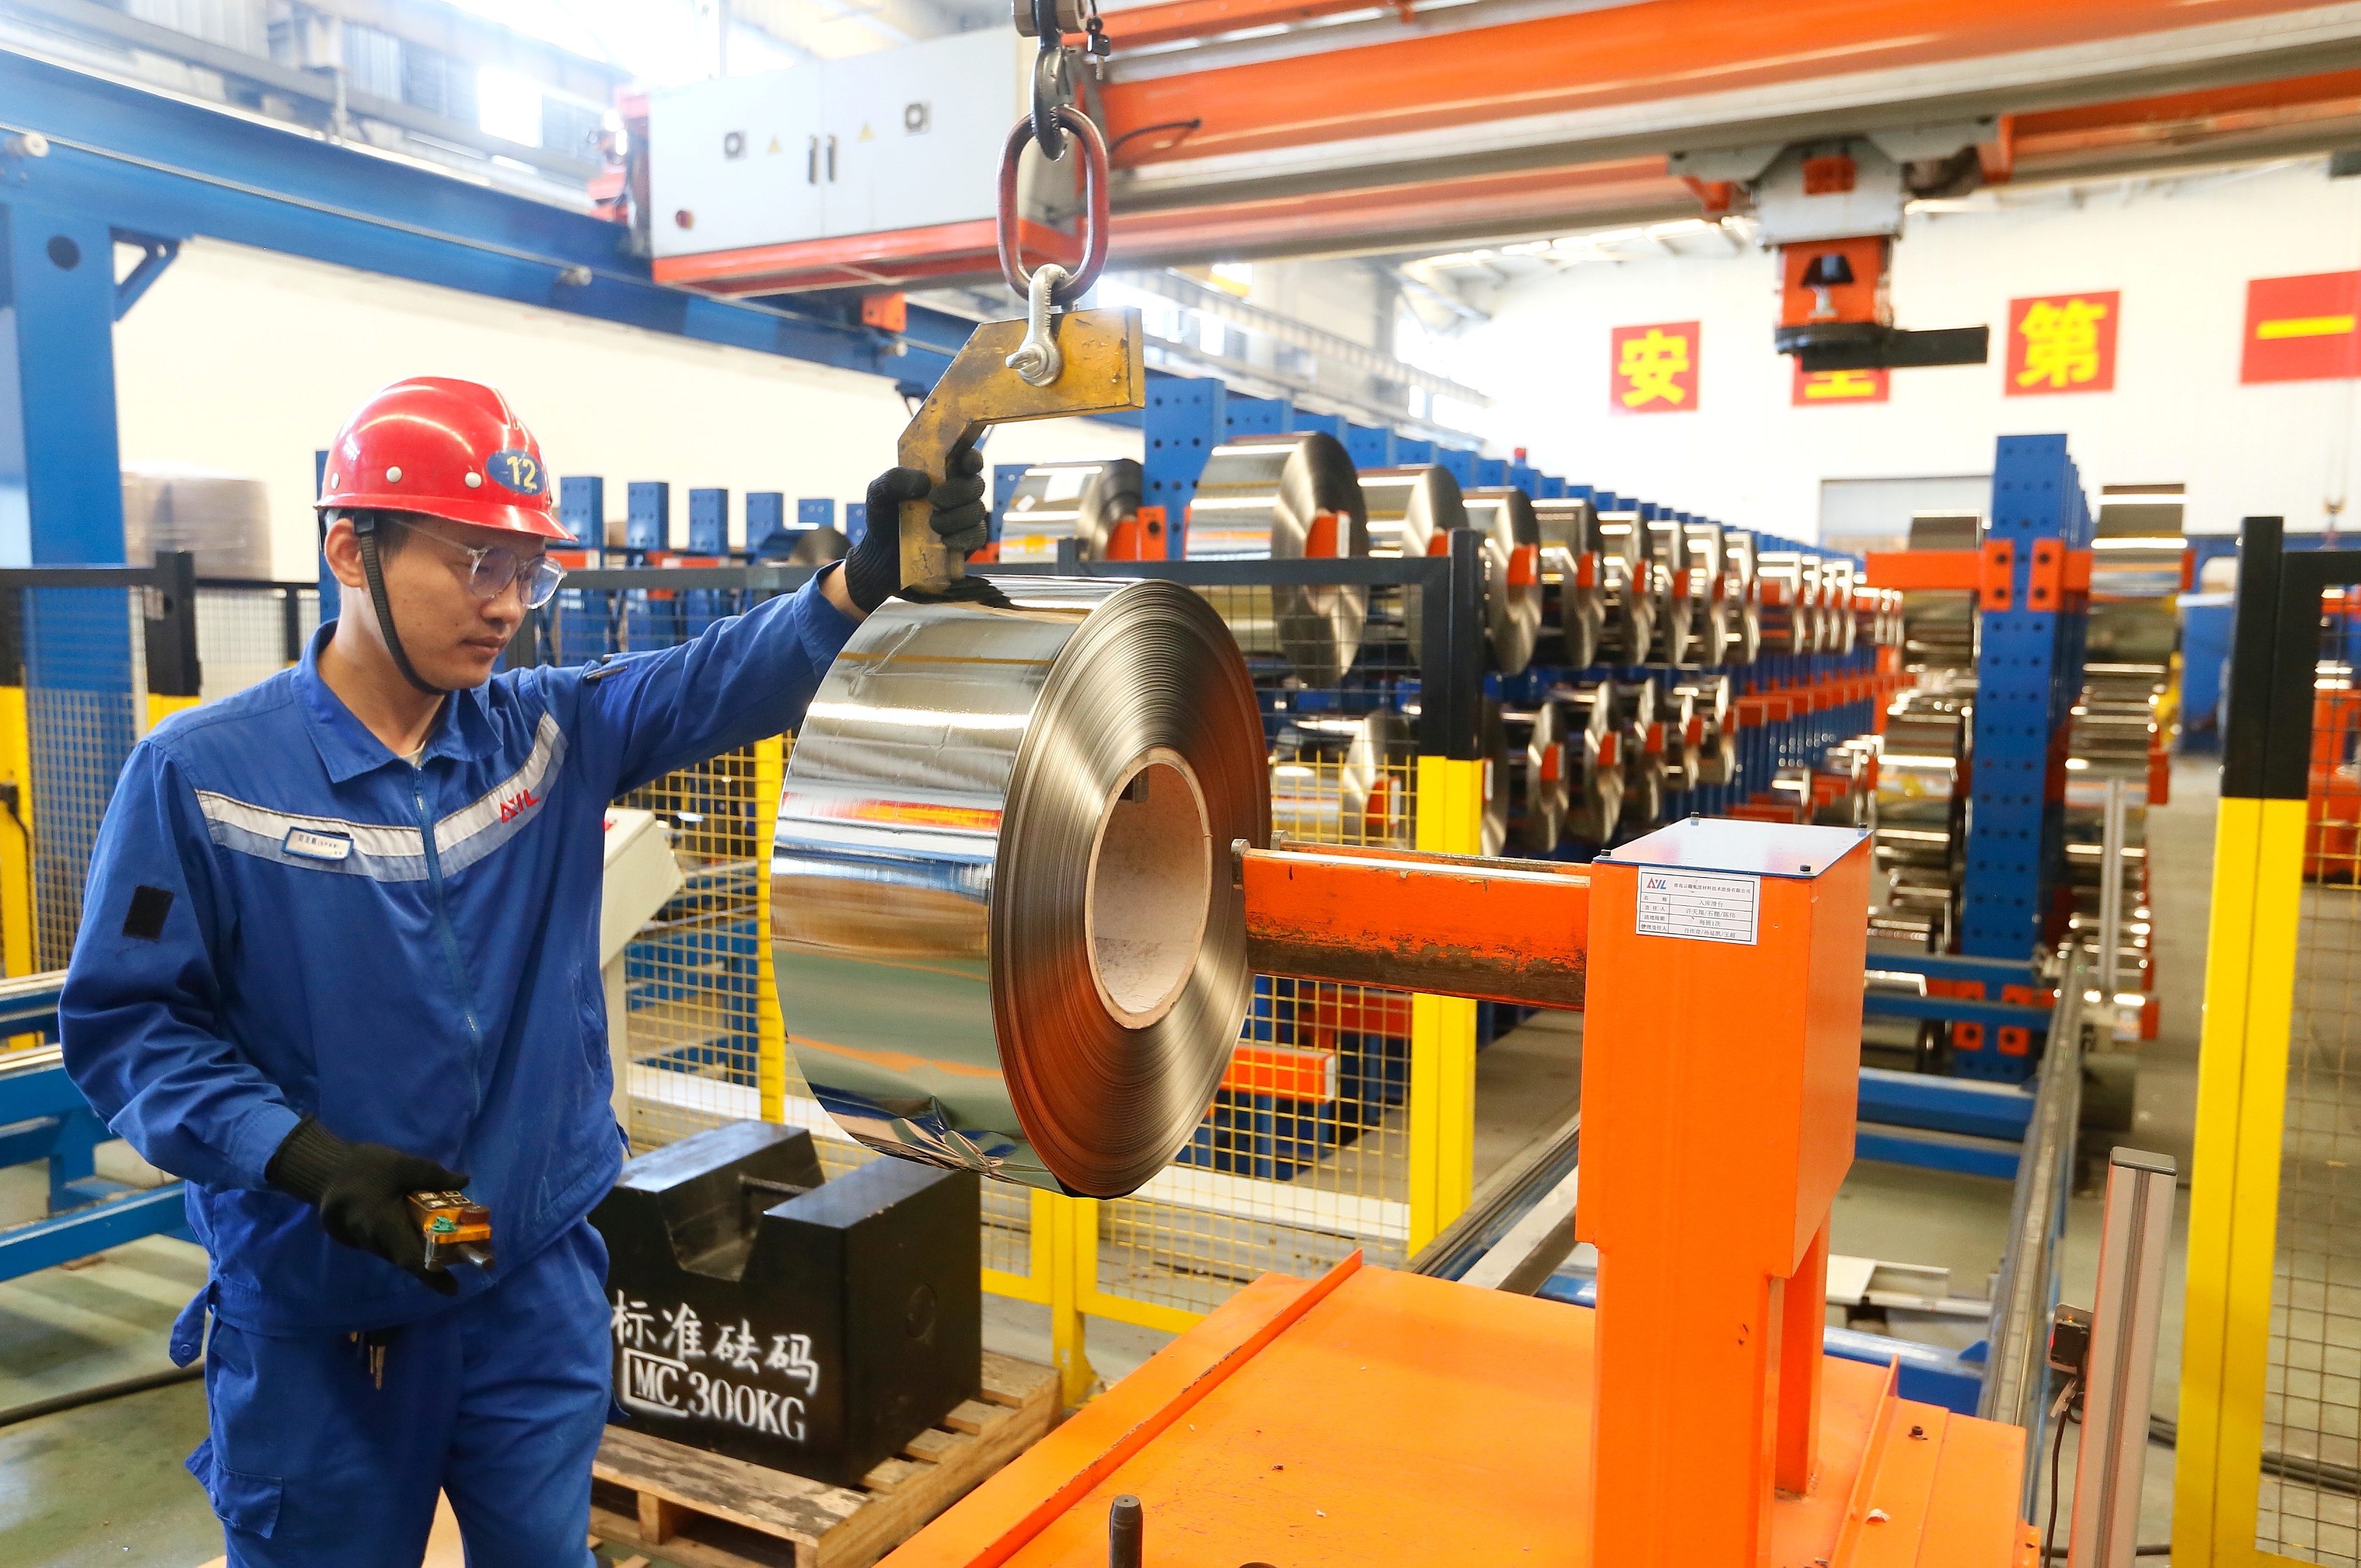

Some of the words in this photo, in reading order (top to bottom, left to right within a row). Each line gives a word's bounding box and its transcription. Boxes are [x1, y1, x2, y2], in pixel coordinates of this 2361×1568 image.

[507, 455, 537, 490] 12
[1673, 883, 1751, 894] 青岛云路先进材料技术股份有限公司
[611, 1288, 820, 1396] 标准砝码
[687, 1371, 806, 1442] 300KG
